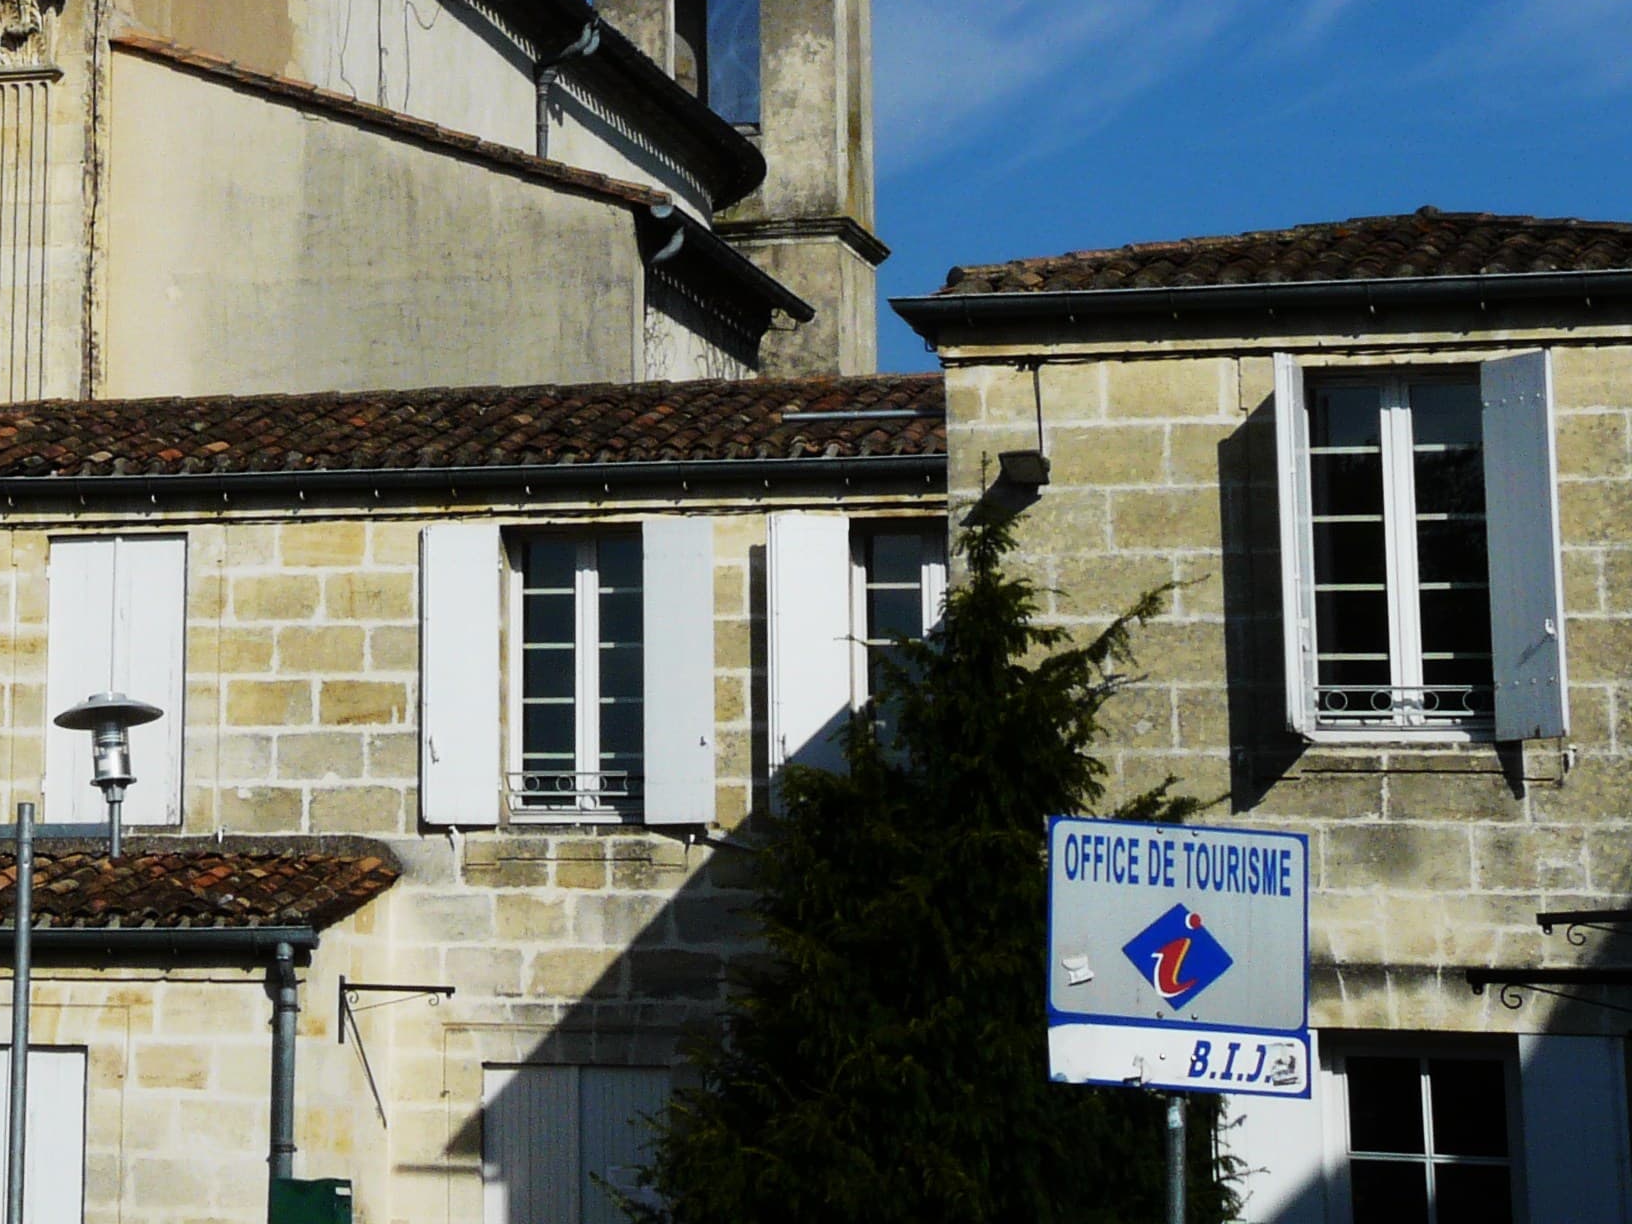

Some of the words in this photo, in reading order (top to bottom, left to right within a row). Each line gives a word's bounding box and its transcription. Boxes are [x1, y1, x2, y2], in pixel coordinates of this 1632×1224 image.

[1064, 833, 1139, 885] OFFICE
[1148, 839, 1175, 888] DE
[1183, 842, 1292, 897] TOURISME
